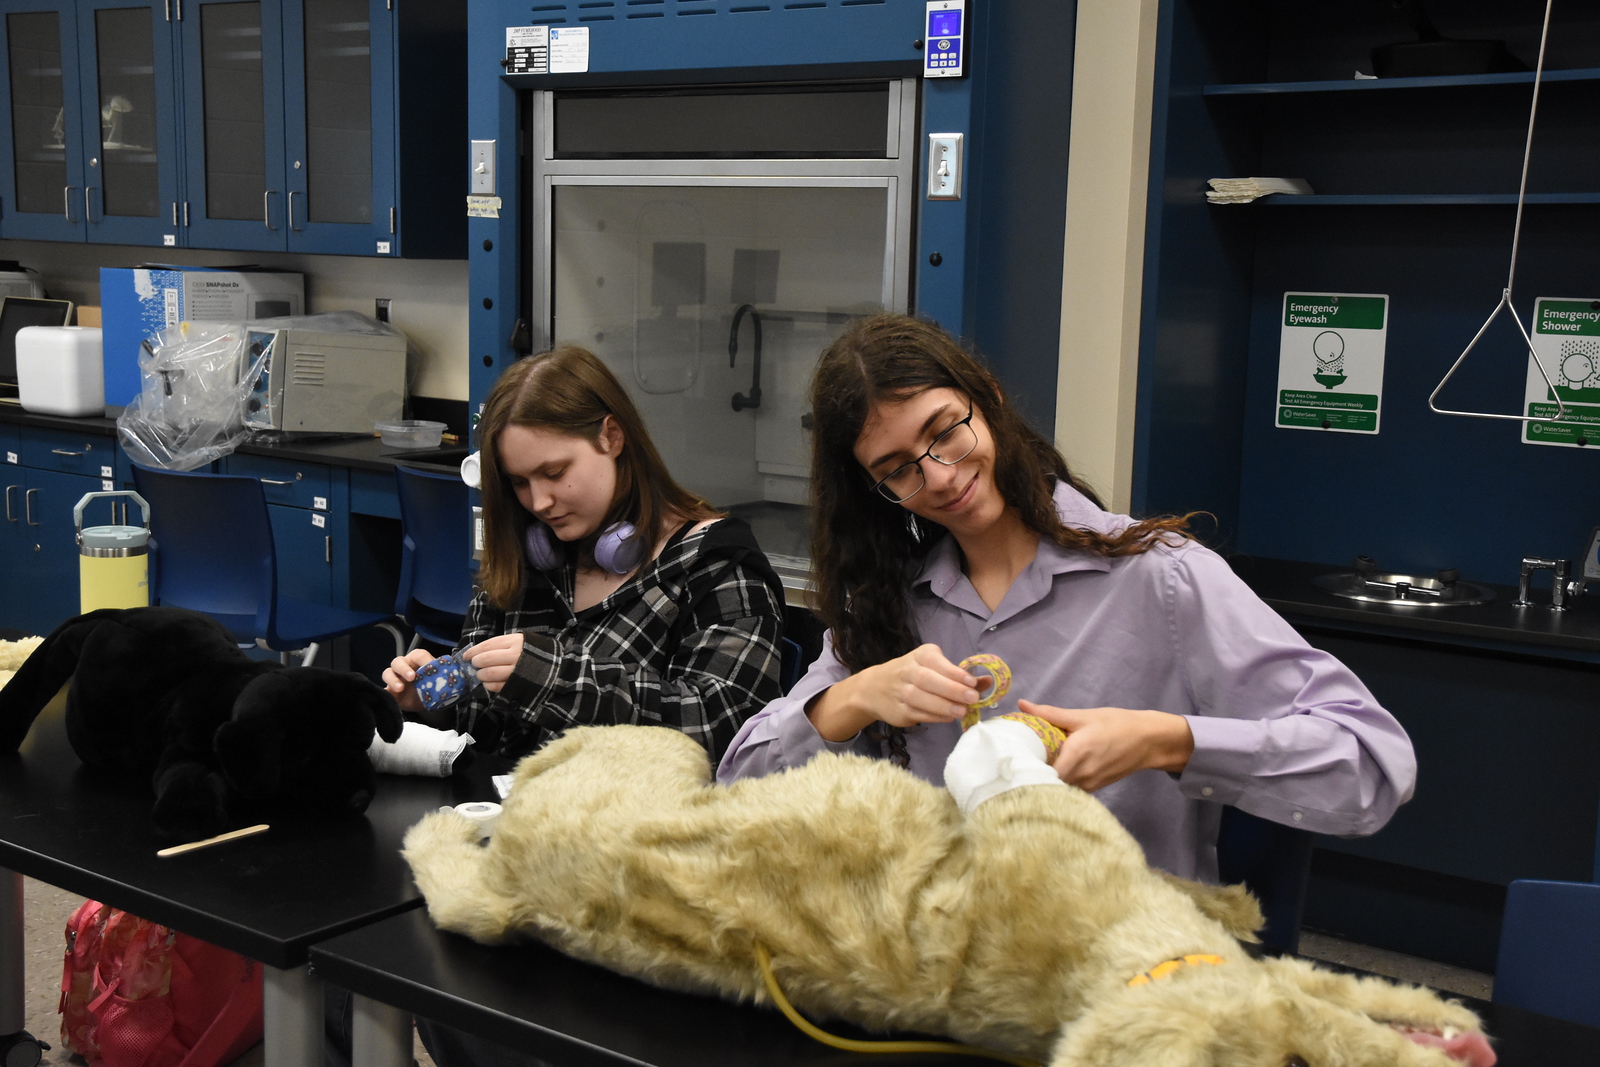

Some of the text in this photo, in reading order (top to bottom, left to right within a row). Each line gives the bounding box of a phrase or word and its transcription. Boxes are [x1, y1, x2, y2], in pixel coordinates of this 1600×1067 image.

[1290, 302, 1339, 315] Emergency
[1290, 314, 1327, 325] Eyewash
[1544, 308, 1600, 322] Emergency
[1542, 320, 1582, 332] Shower
[1552, 413, 1580, 421] Ergency
